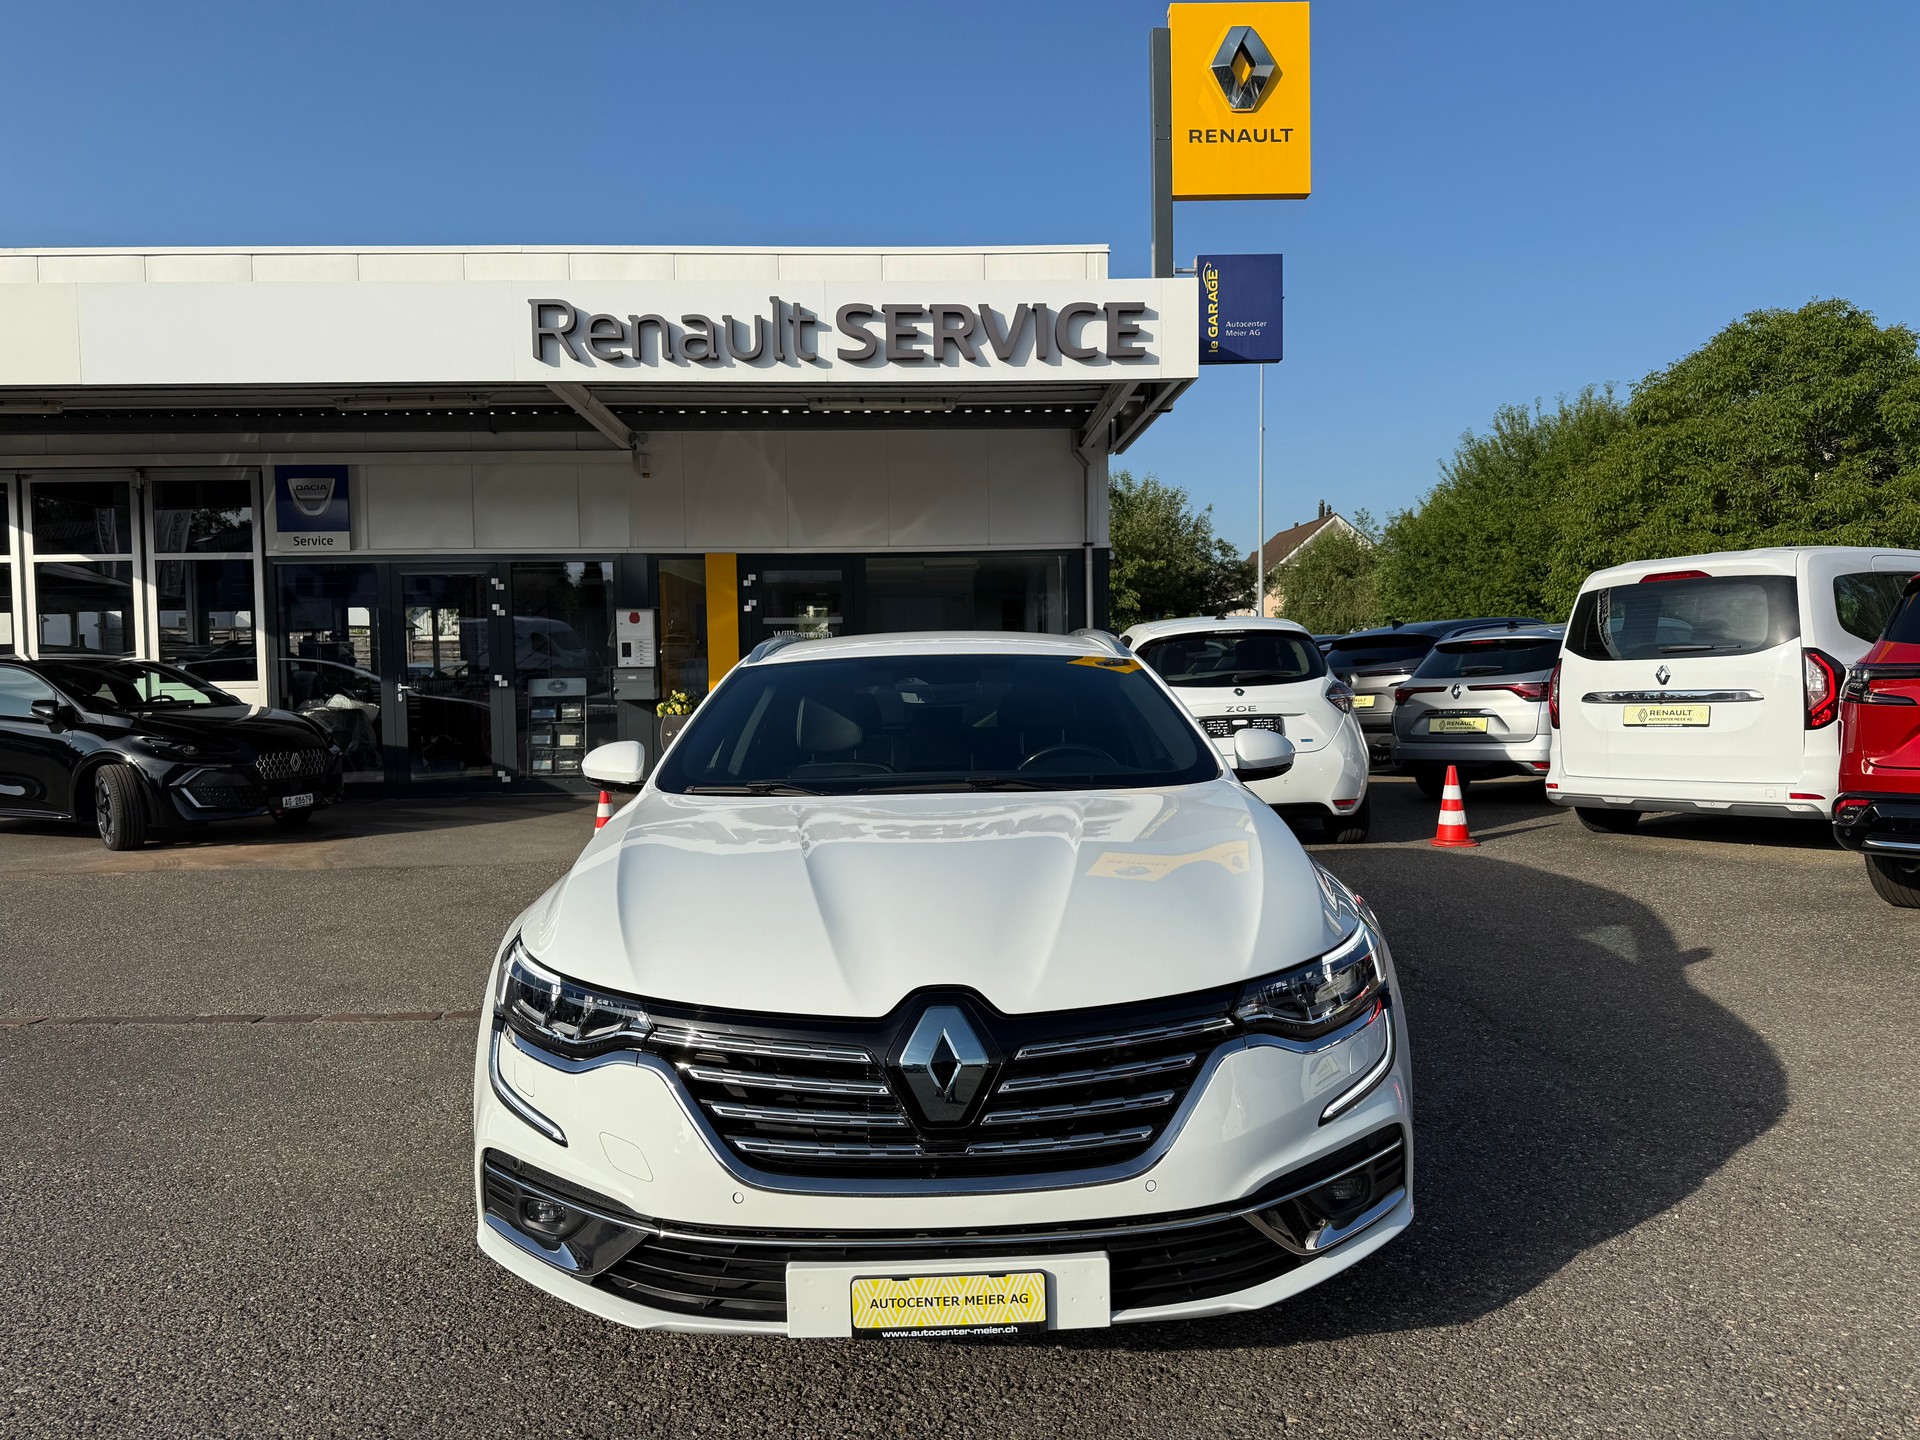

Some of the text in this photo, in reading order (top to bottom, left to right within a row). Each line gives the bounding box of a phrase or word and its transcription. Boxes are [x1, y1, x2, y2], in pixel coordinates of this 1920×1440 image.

[1188, 128, 1294, 143] RENAULT
[1207, 269, 1219, 353] le GARAGE
[527, 295, 1146, 362] Renault SERVICE
[1225, 329, 1247, 337] Meier
[293, 535, 334, 546] Service
[1225, 705, 1258, 713] ZOE
[869, 1293, 1029, 1309] AUTOCENTER MEIER AG
[881, 1324, 1019, 1339] www.autocenter-meier.ch
